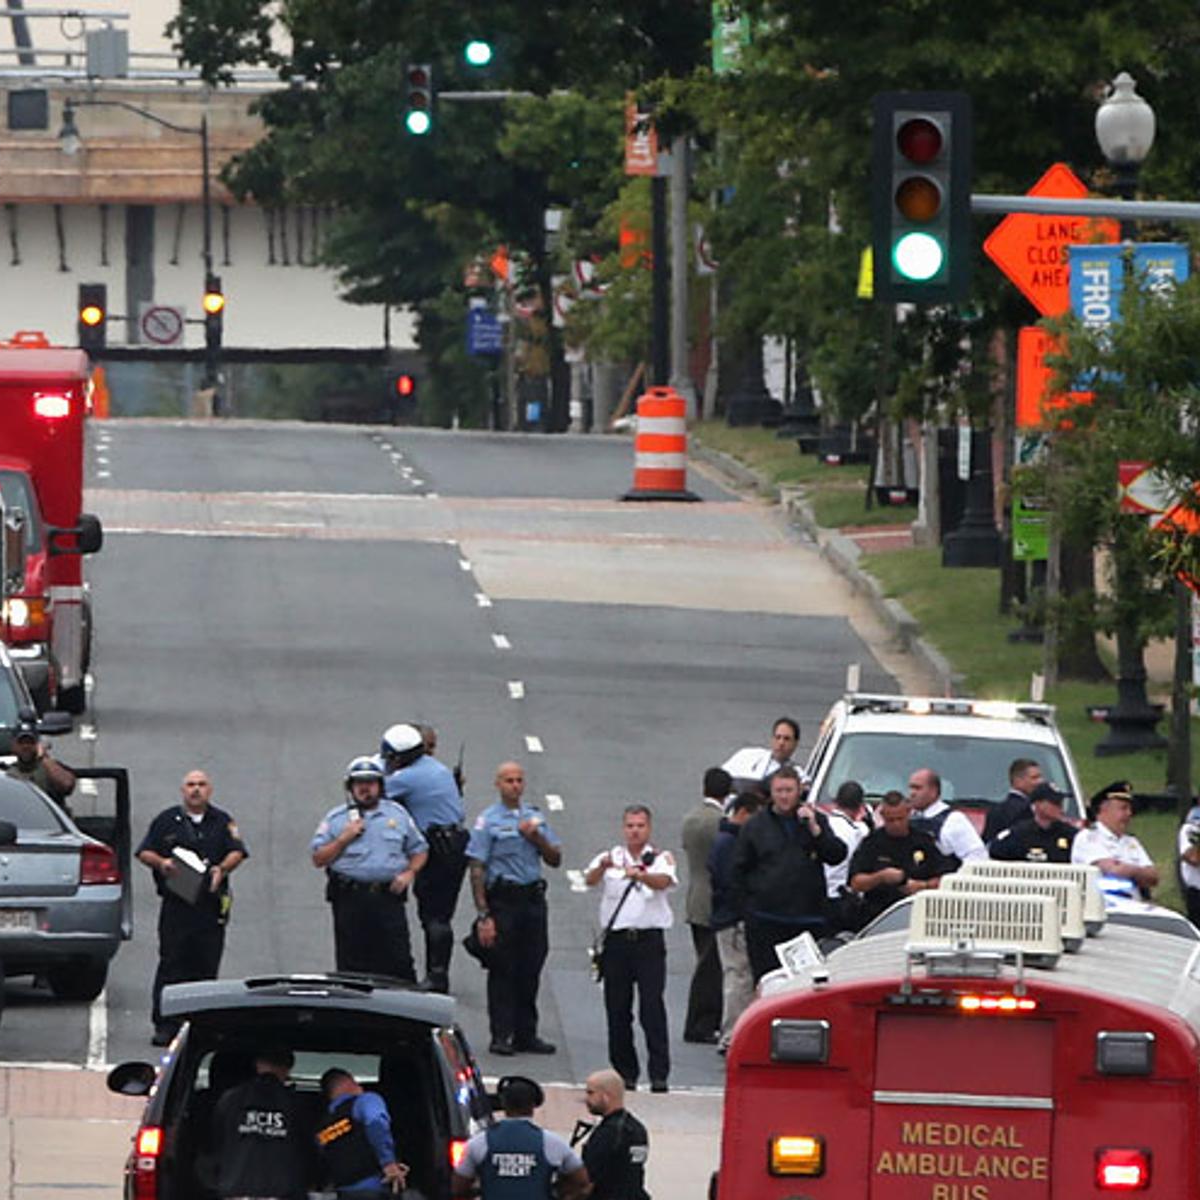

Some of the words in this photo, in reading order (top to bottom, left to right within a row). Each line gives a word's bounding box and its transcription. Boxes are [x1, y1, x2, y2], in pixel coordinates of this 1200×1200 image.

[1036, 222, 1081, 241] LANE
[1027, 246, 1069, 265] CLOS
[1031, 268, 1070, 288] AHE
[902, 1122, 1024, 1148] MEDICAL
[876, 1151, 1049, 1180] AMBULANCE
